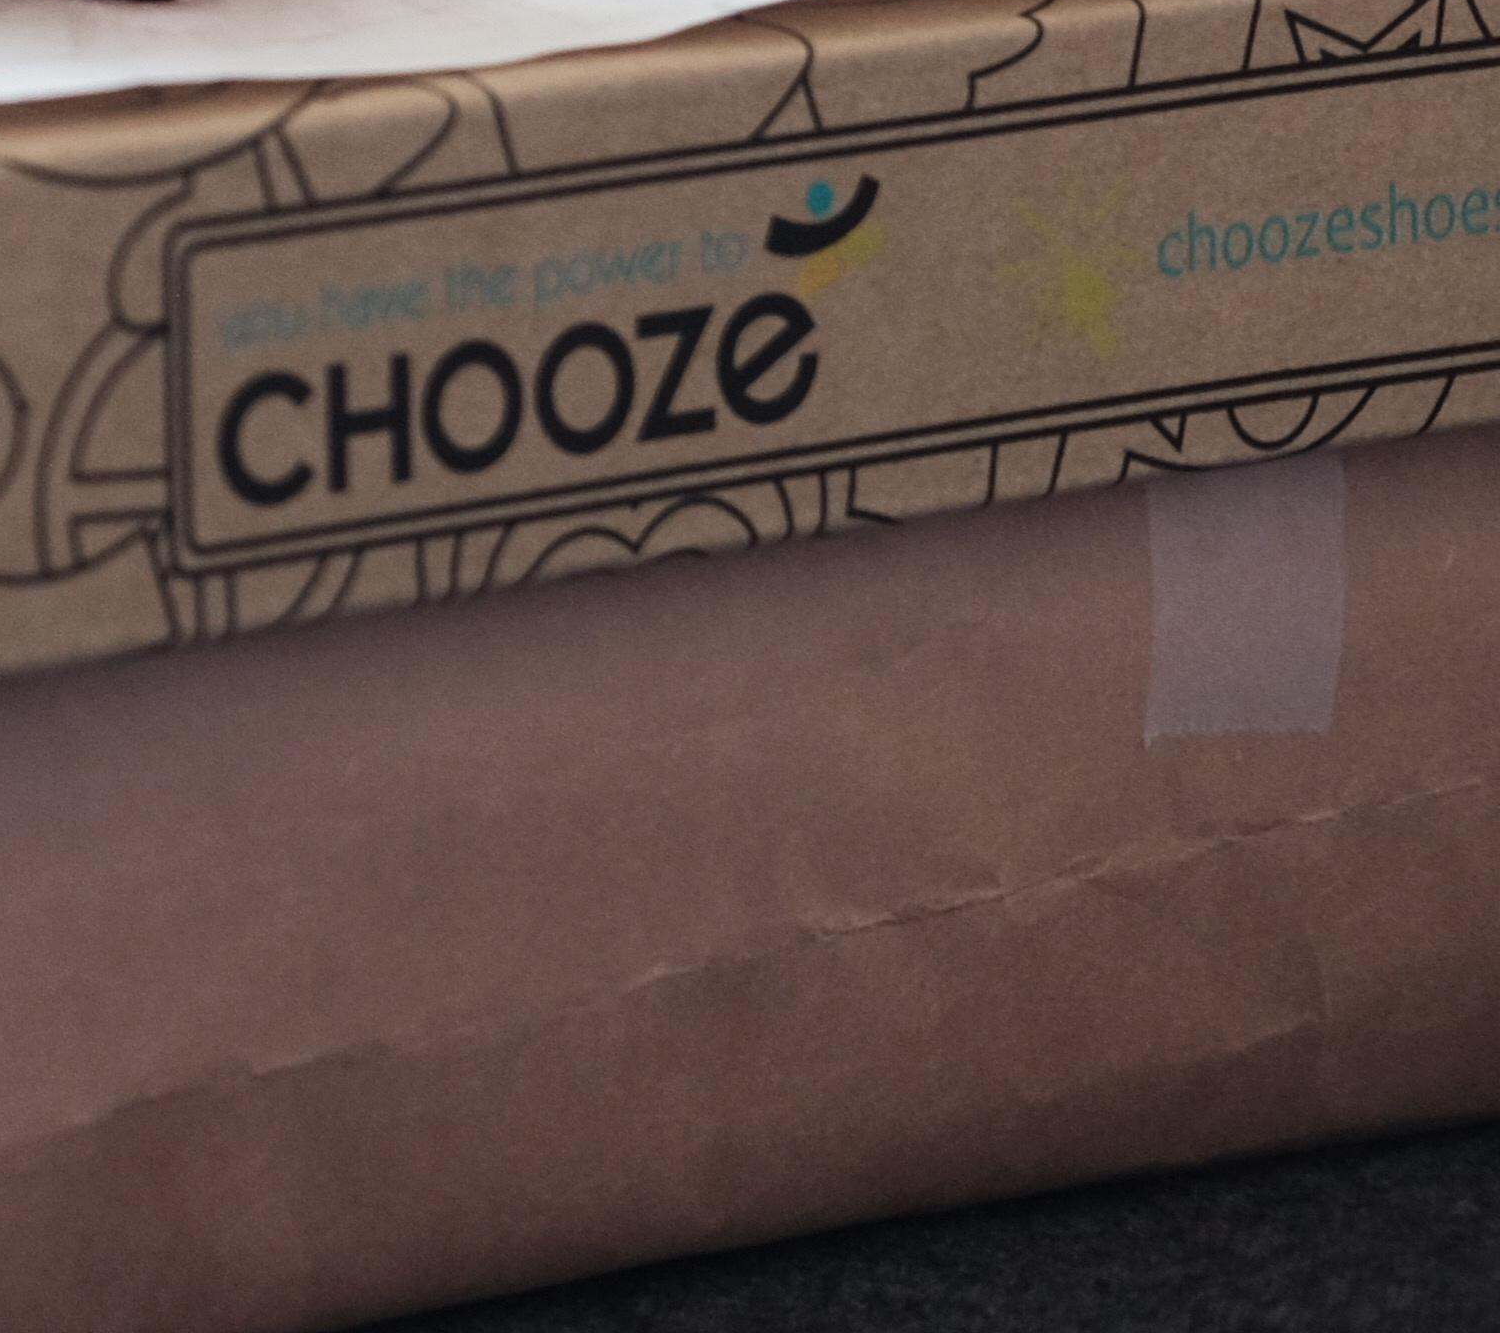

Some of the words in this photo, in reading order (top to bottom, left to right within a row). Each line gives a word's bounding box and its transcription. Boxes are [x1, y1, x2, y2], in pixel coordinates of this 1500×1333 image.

[443, 261, 519, 311] the
[533, 239, 682, 310] power
[699, 229, 751, 276] to
[1157, 181, 1500, 278] choozeshoe
